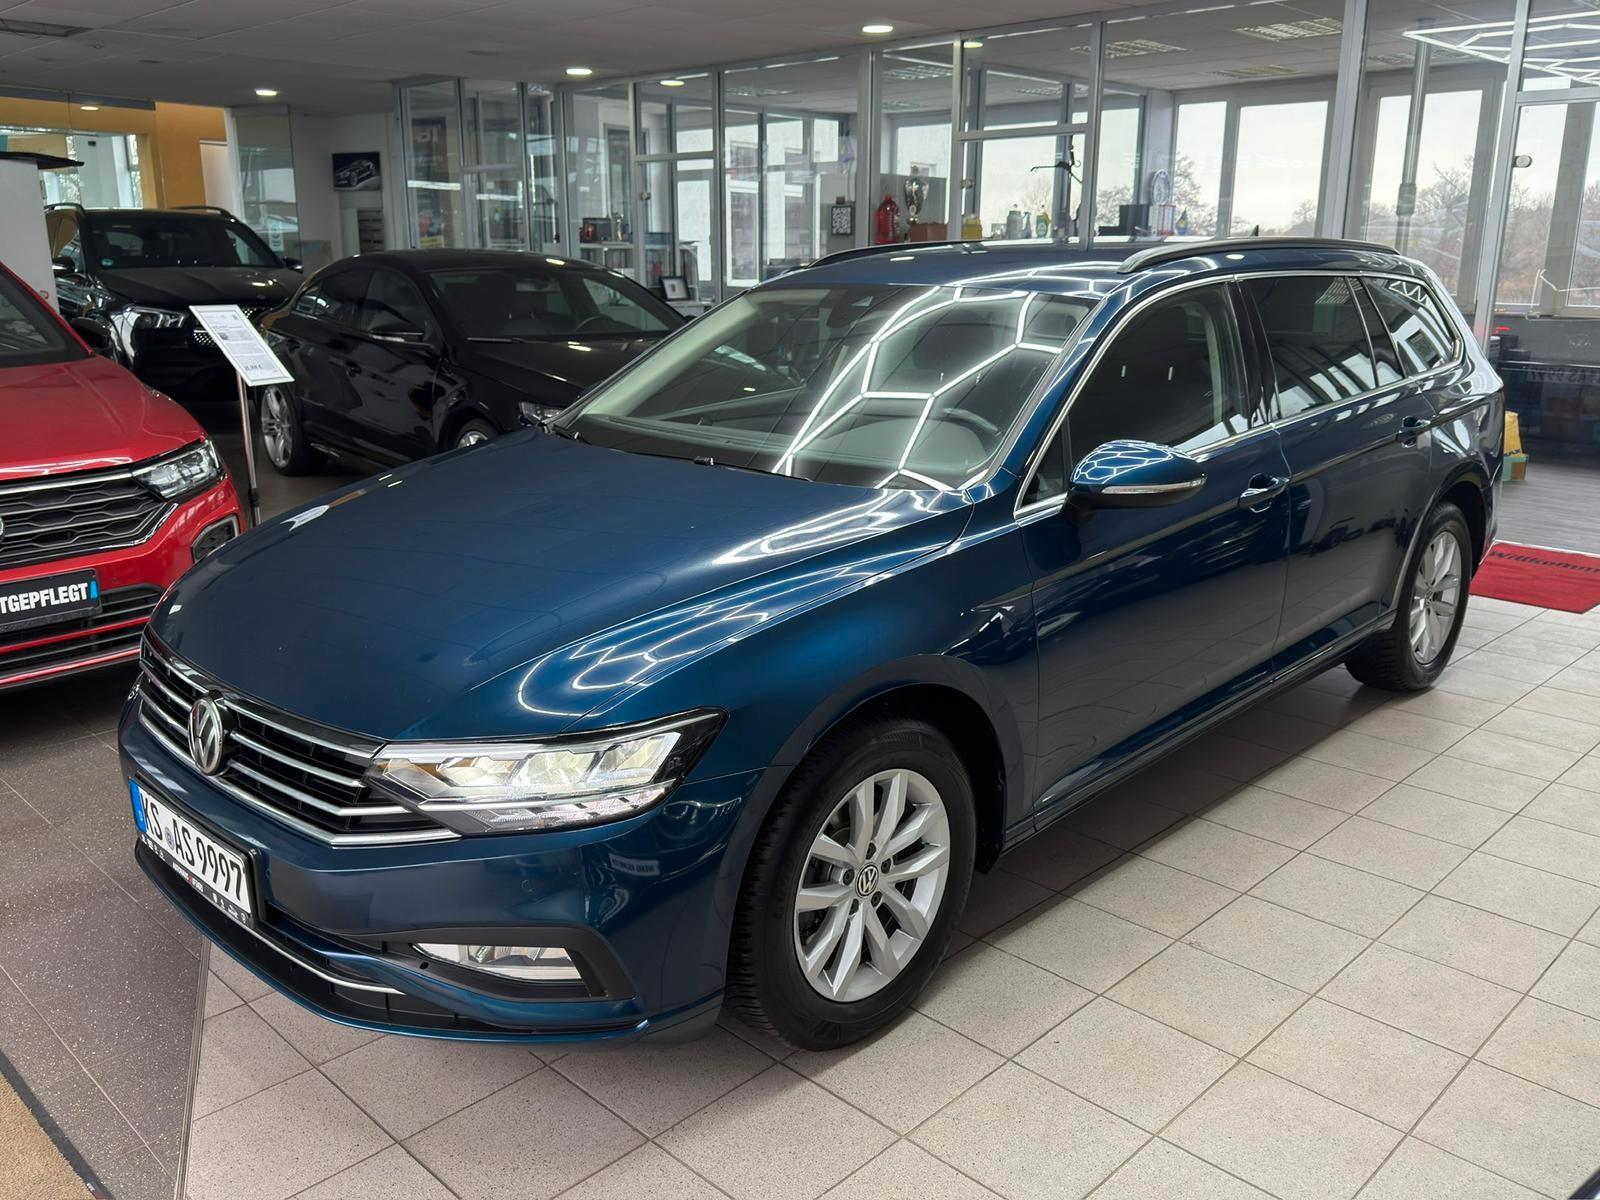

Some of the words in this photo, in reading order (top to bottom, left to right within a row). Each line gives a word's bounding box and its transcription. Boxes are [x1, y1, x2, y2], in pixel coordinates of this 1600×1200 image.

[0, 582, 88, 614] TGEPFLEGT
[140, 793, 163, 841] KS
[172, 819, 195, 866] AS
[196, 837, 241, 901] 9997
[858, 866, 878, 894] VW
